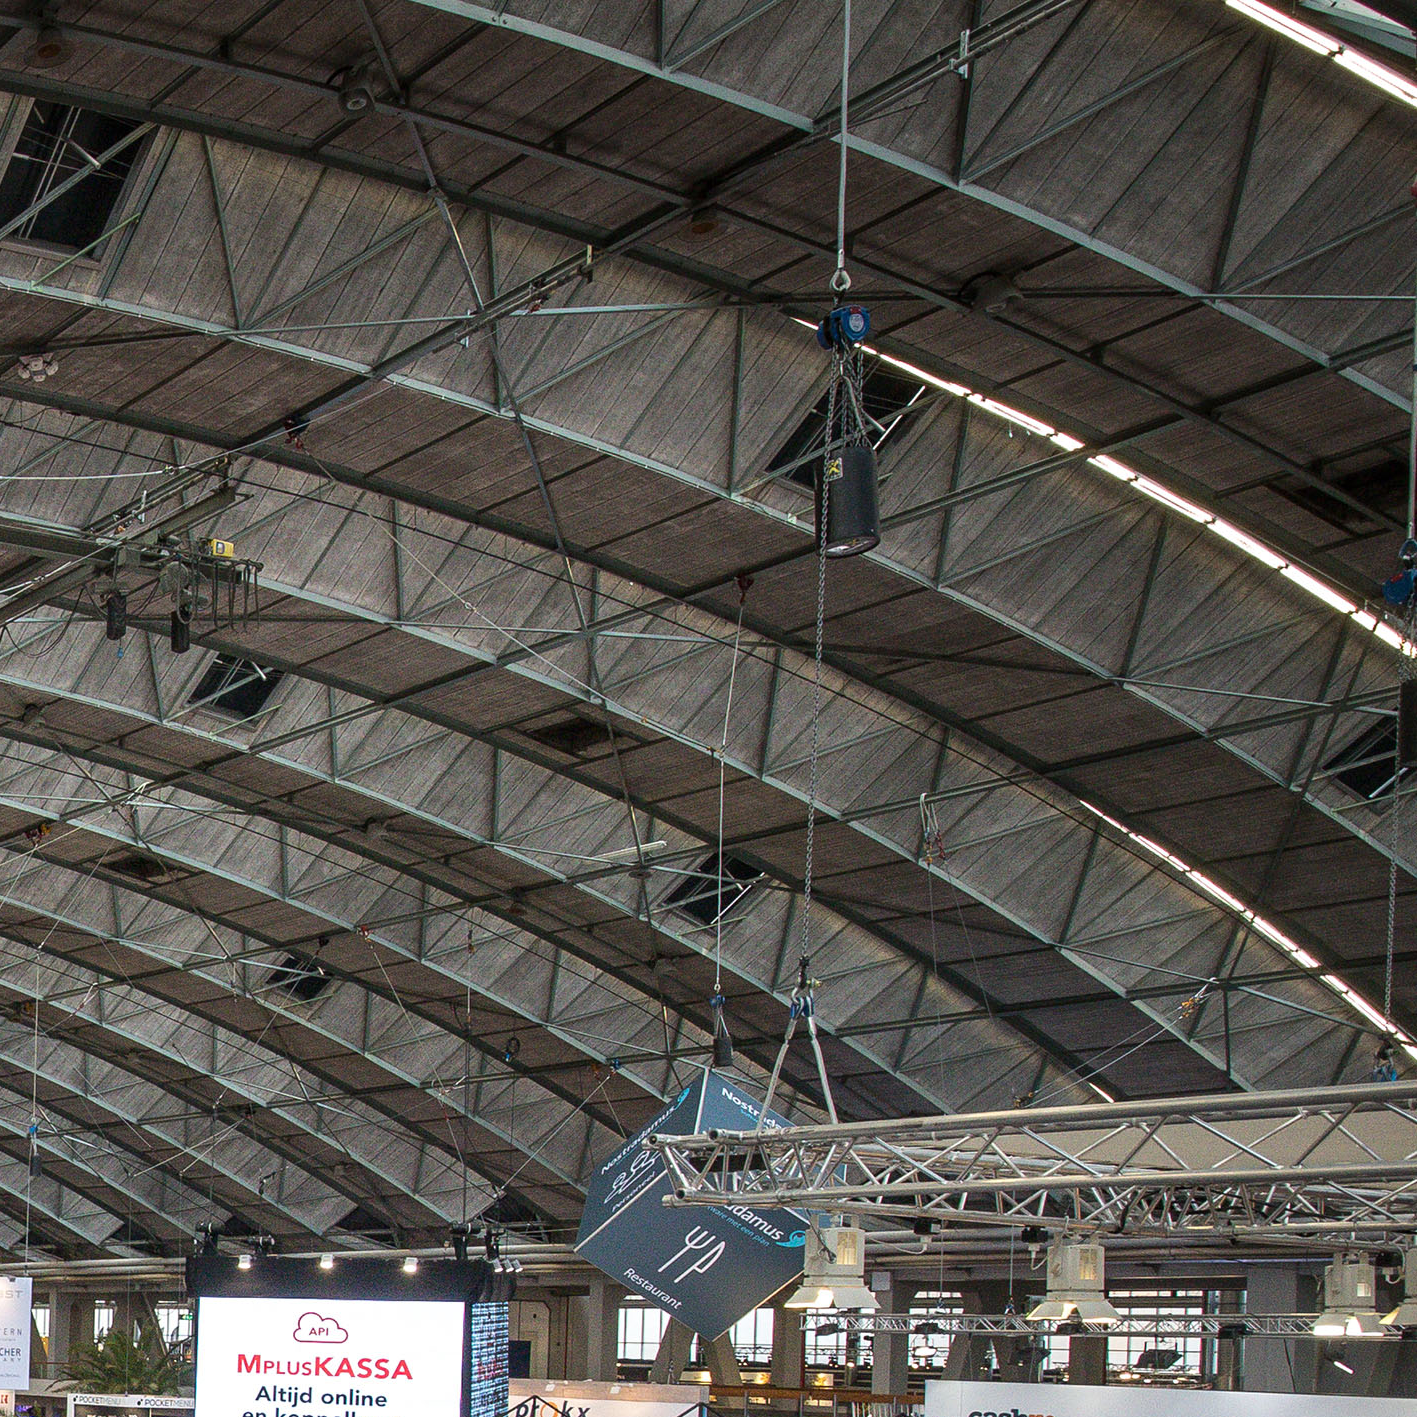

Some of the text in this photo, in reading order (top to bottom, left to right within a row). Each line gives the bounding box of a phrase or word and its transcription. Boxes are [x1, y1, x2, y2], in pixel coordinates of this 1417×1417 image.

[601, 1106, 676, 1175] Nostradamus
[623, 1268, 682, 1310] Restaurant
[309, 1327, 329, 1337] API
[144, 1398, 194, 1407] POCKETMENU
[255, 1385, 387, 1407] Altijd online
